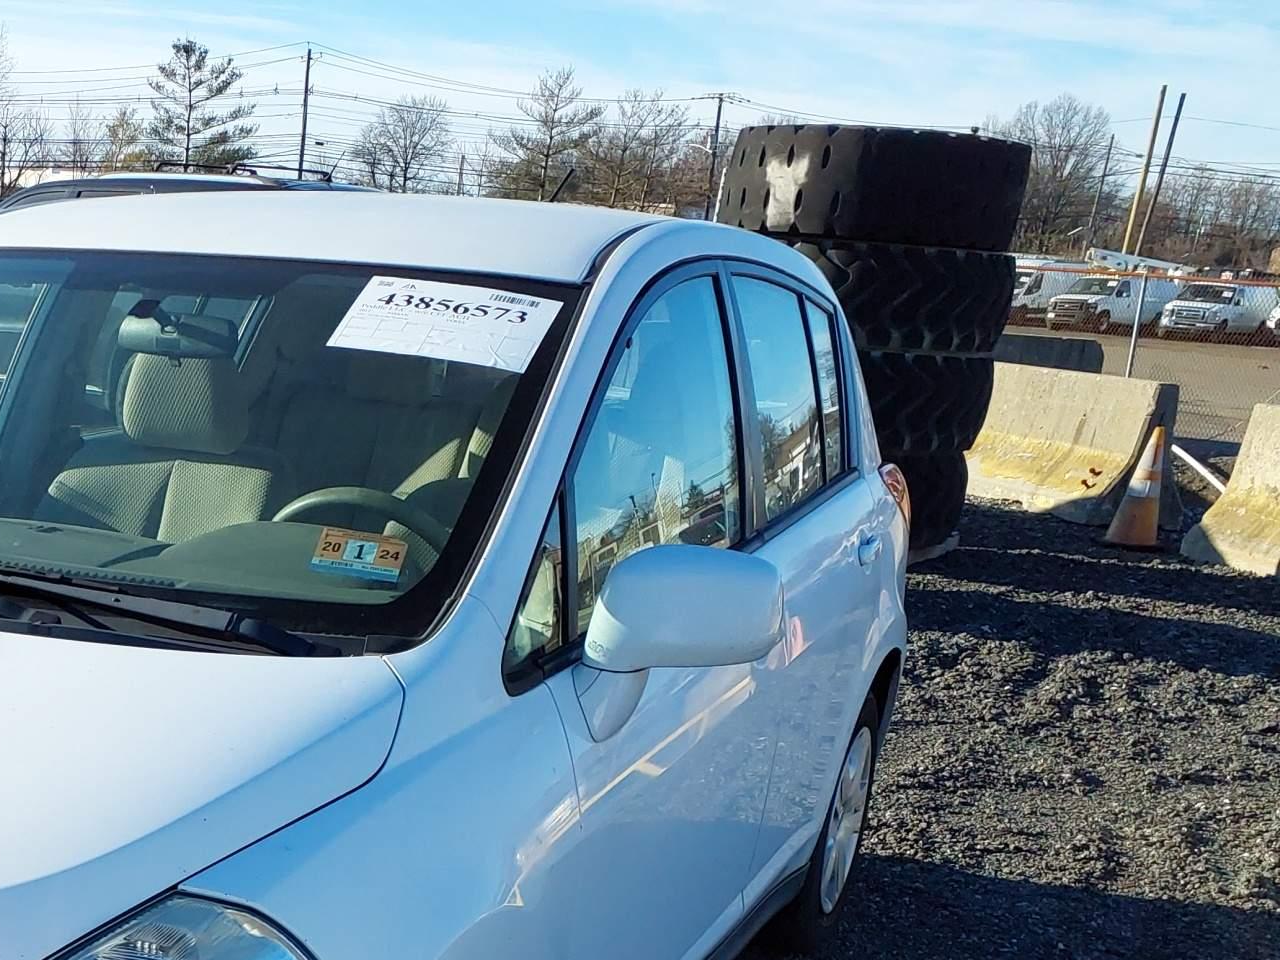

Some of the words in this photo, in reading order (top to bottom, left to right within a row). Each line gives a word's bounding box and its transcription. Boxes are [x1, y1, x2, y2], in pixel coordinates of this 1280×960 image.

[377, 293, 528, 323] 43856573
[322, 541, 342, 553] 20
[353, 543, 366, 560] 1
[378, 549, 401, 561] 24
